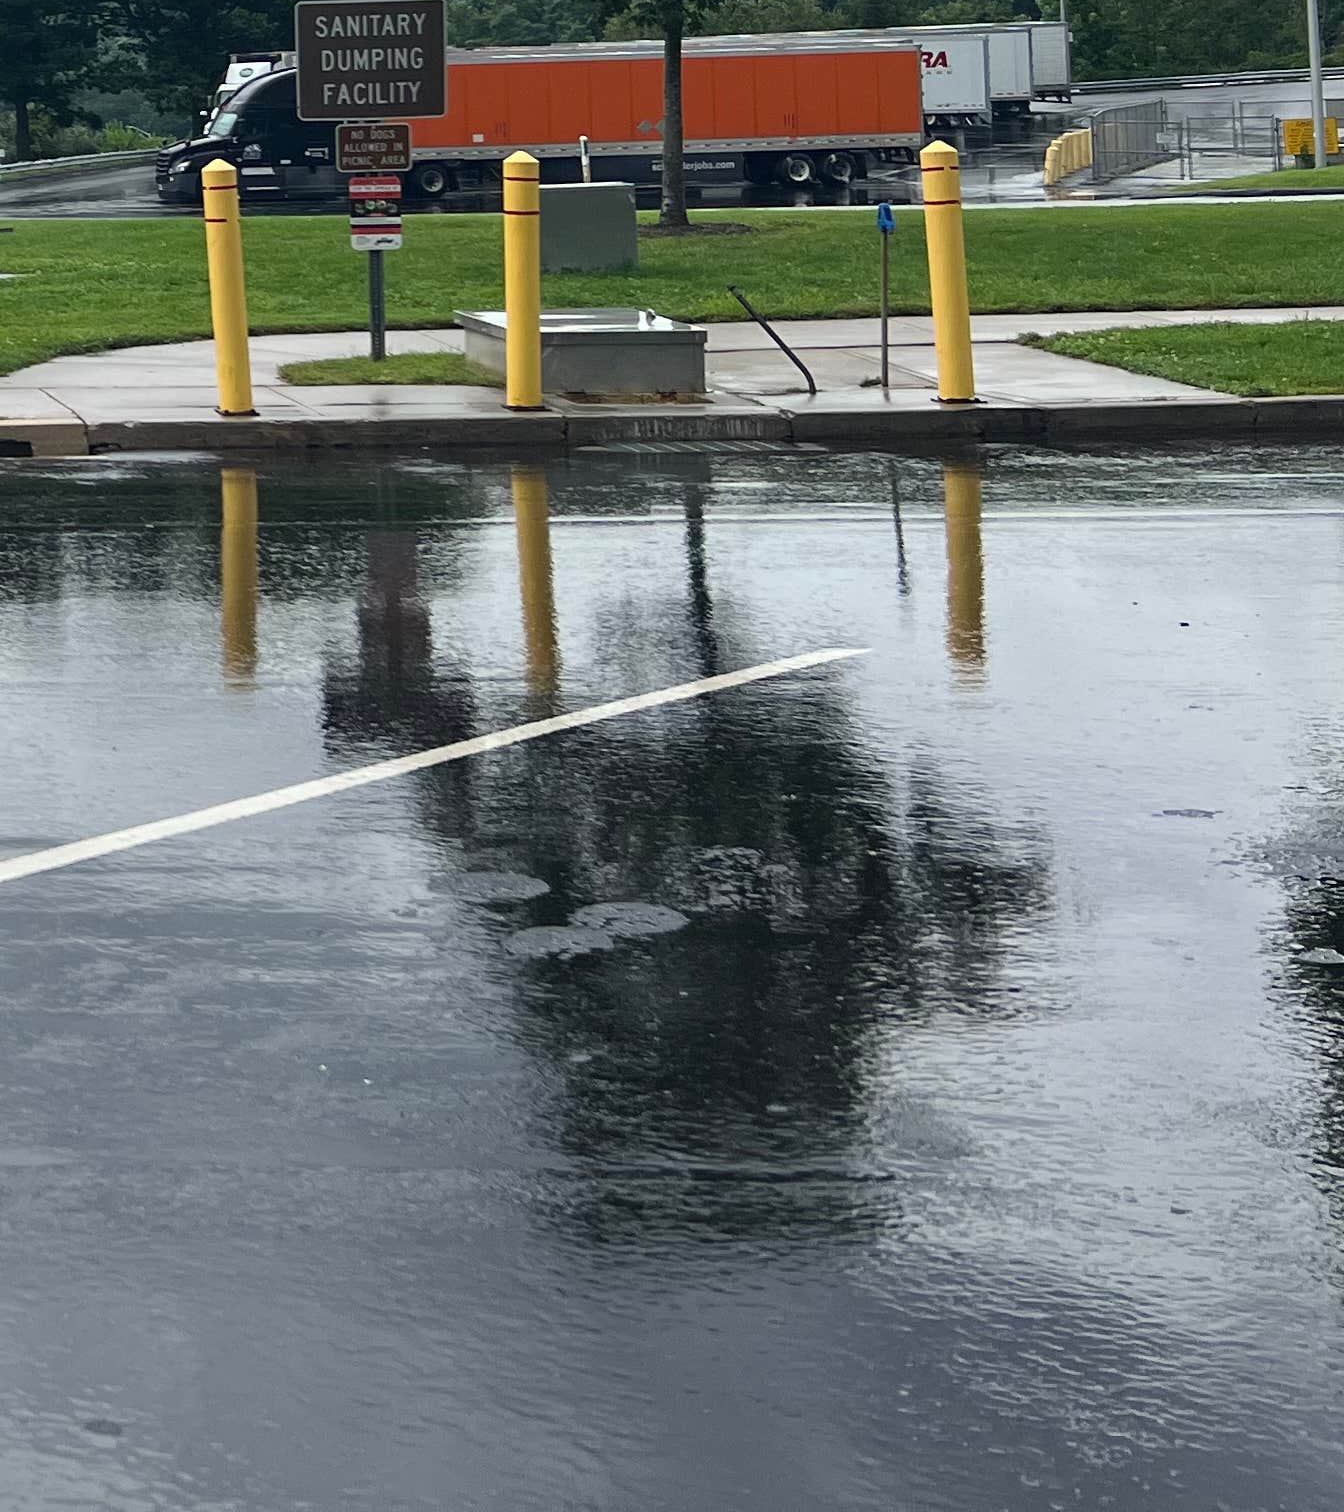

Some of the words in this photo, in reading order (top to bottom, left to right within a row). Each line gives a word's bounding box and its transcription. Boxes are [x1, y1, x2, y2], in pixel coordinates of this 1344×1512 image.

[315, 13, 427, 38] SANITARY
[321, 47, 424, 71] DUMPING
[323, 81, 421, 105] FACILITY
